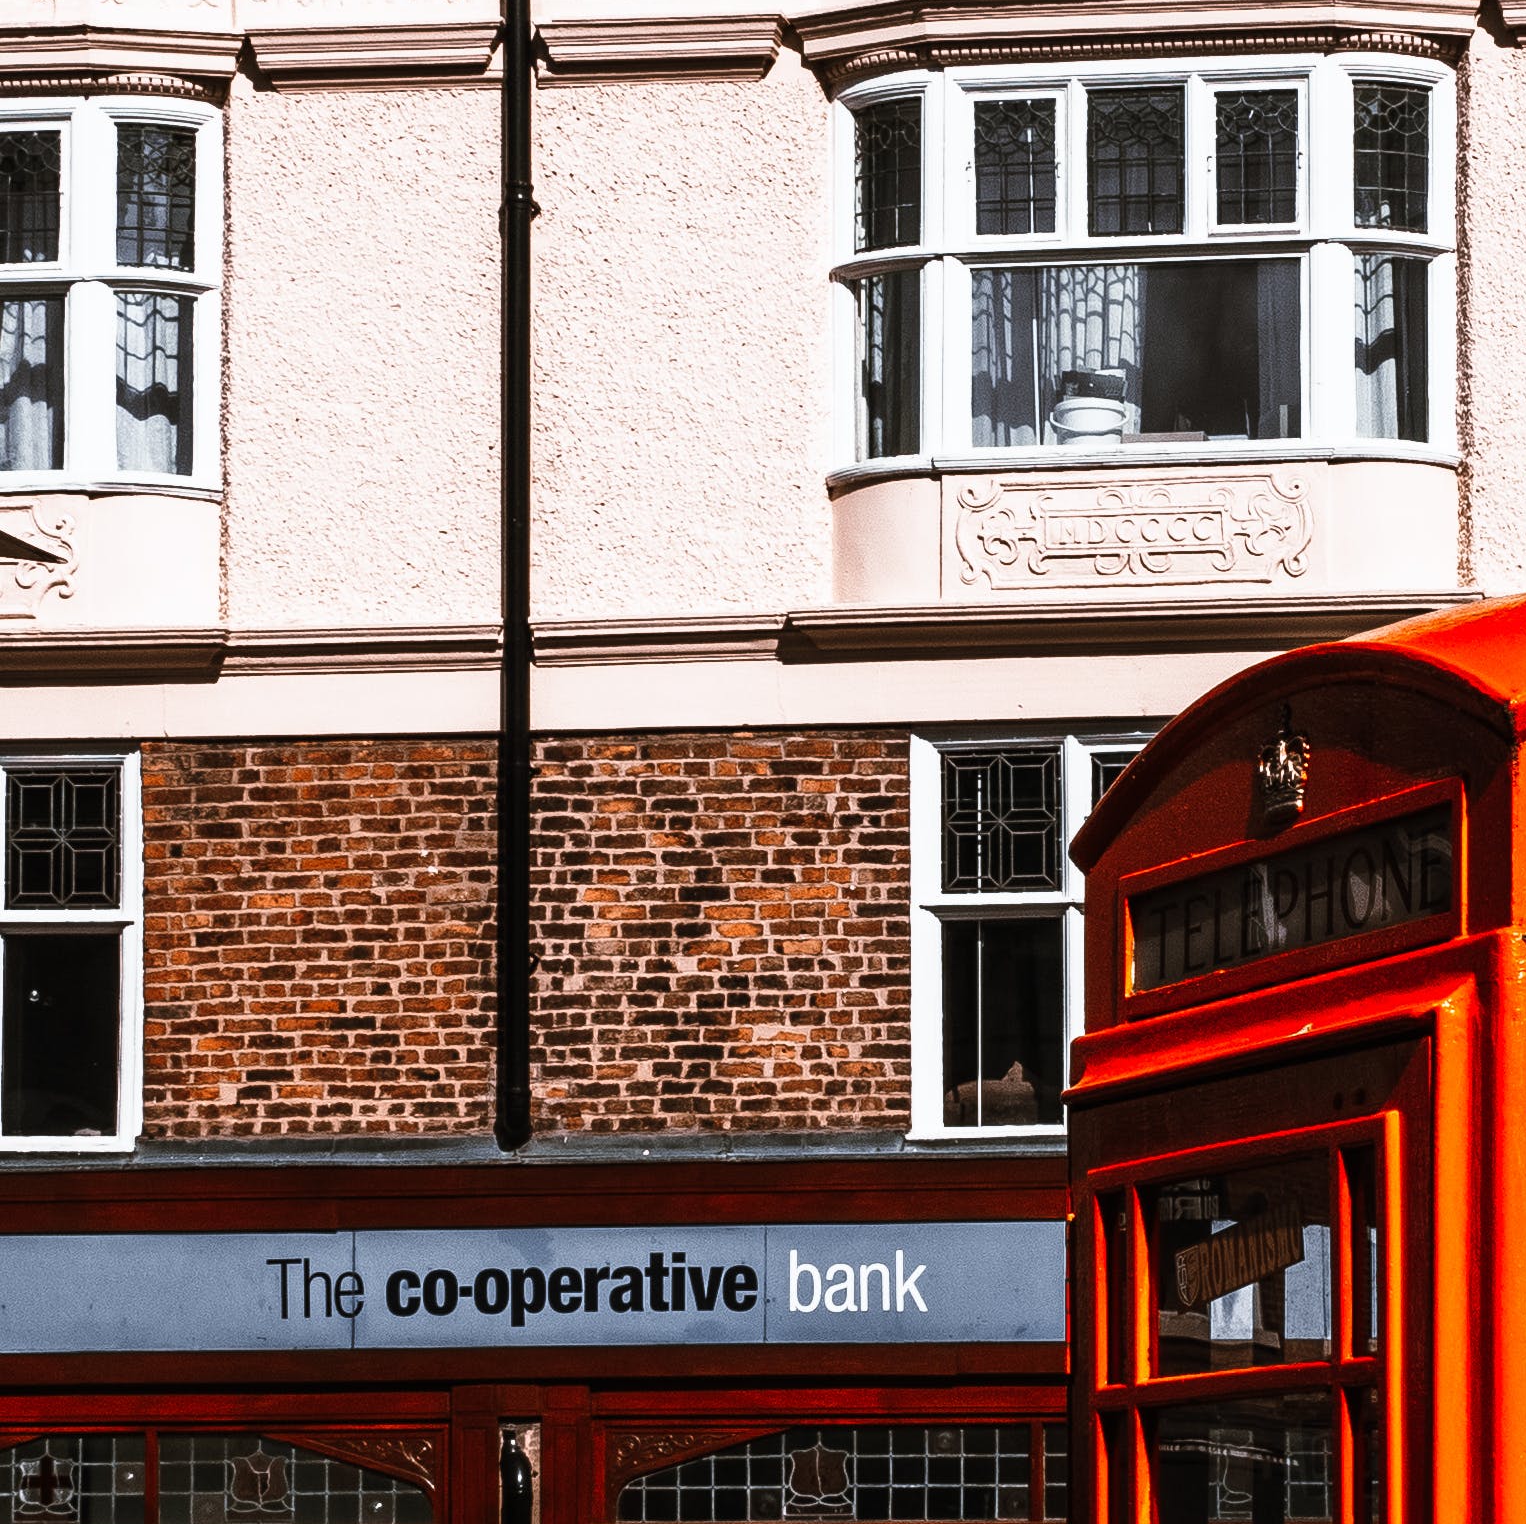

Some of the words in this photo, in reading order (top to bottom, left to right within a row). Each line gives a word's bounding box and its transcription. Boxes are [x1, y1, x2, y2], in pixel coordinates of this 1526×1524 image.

[1151, 827, 1447, 980] TELEPHONE
[266, 1255, 366, 1319] The
[385, 1250, 759, 1327] co-operative
[787, 1249, 929, 1314] bank
[1199, 1213, 1302, 1301] ROMANISMO
